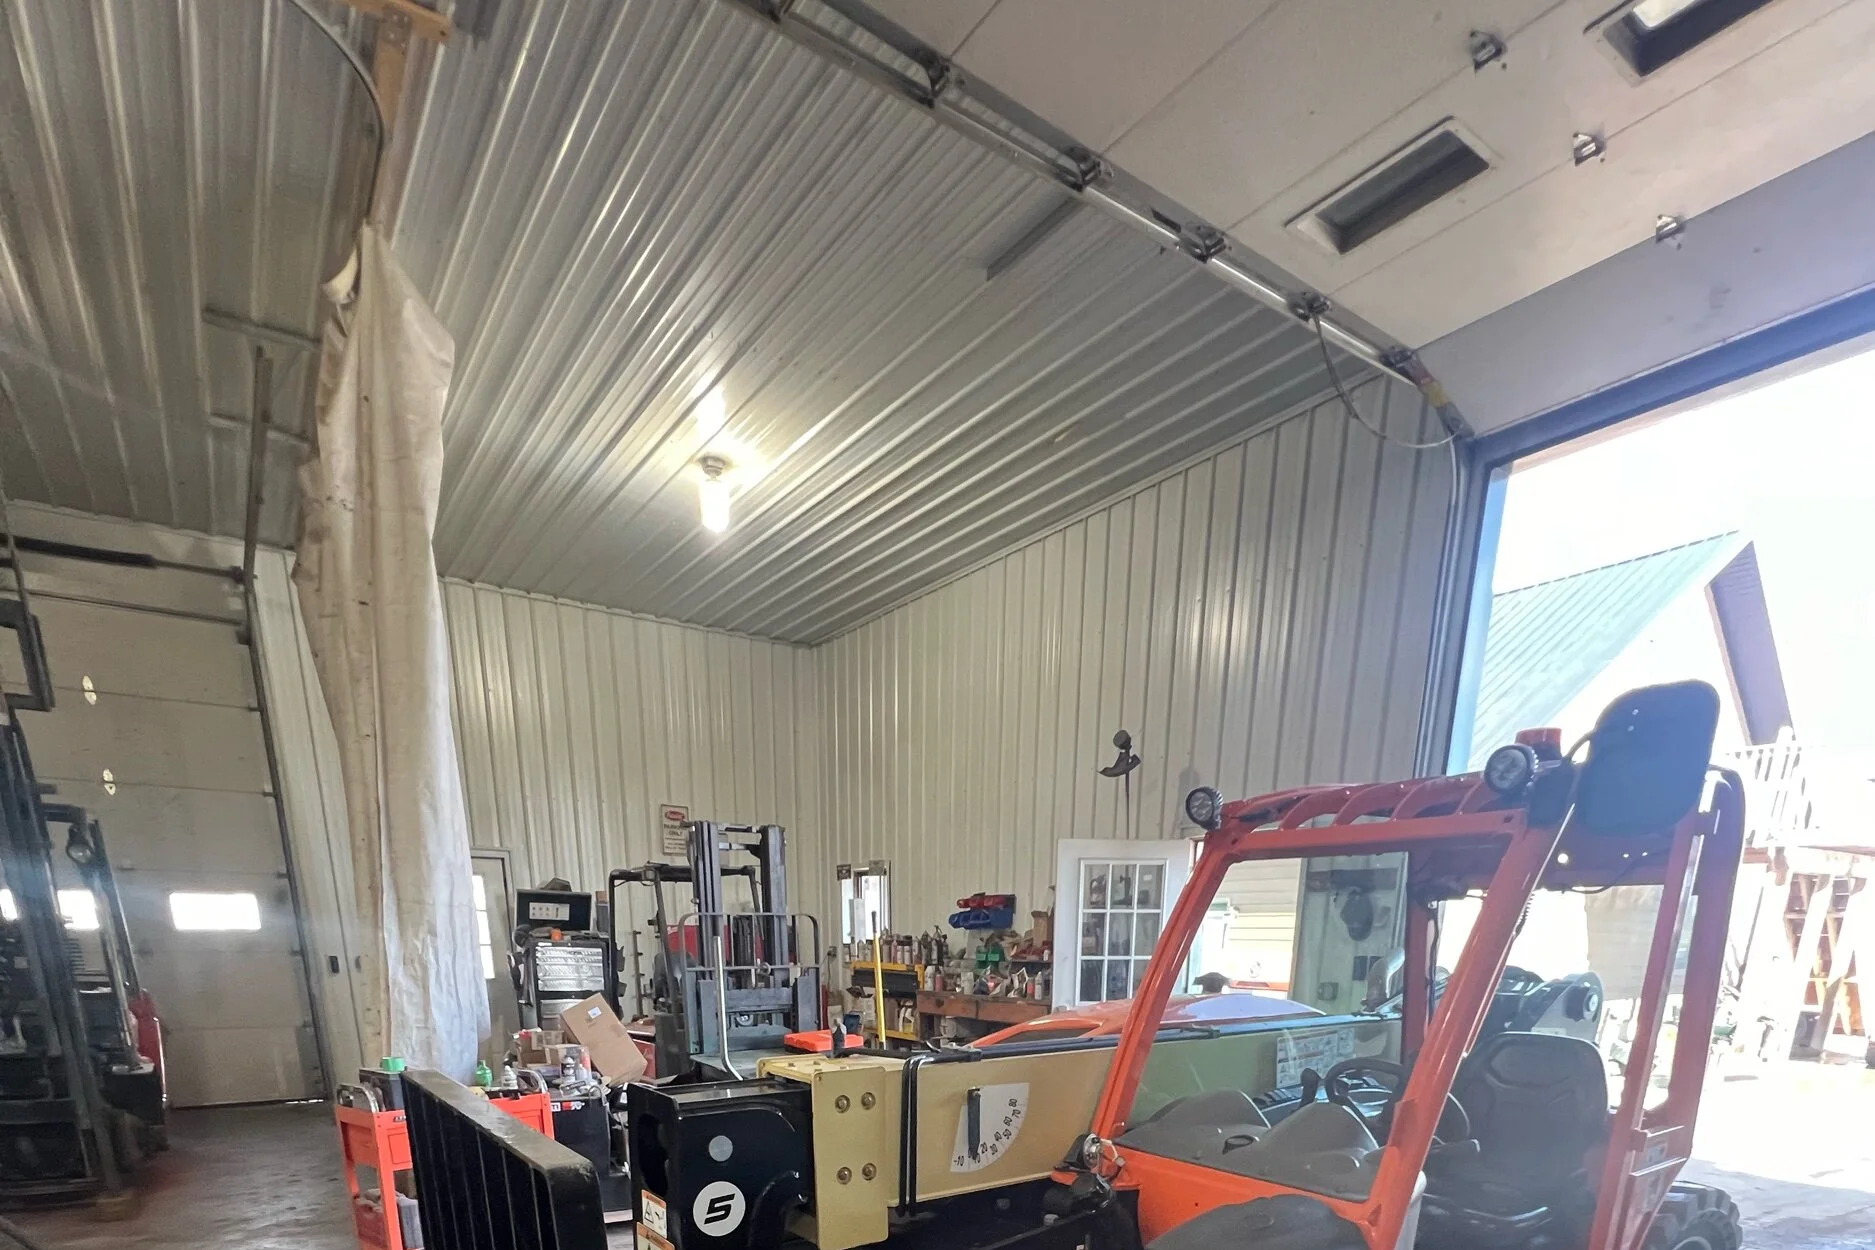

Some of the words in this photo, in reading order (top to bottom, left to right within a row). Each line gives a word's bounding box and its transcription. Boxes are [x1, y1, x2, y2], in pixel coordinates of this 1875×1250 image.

[1008, 1098, 1017, 1107] 80
[1012, 1109, 1021, 1118] 70
[1004, 1116, 1012, 1126] 60
[994, 1131, 1002, 1141] 40
[1003, 1129, 1012, 1139] 50
[980, 1142, 988, 1154] 20
[990, 1143, 998, 1155] 30
[953, 1155, 965, 1167] -10
